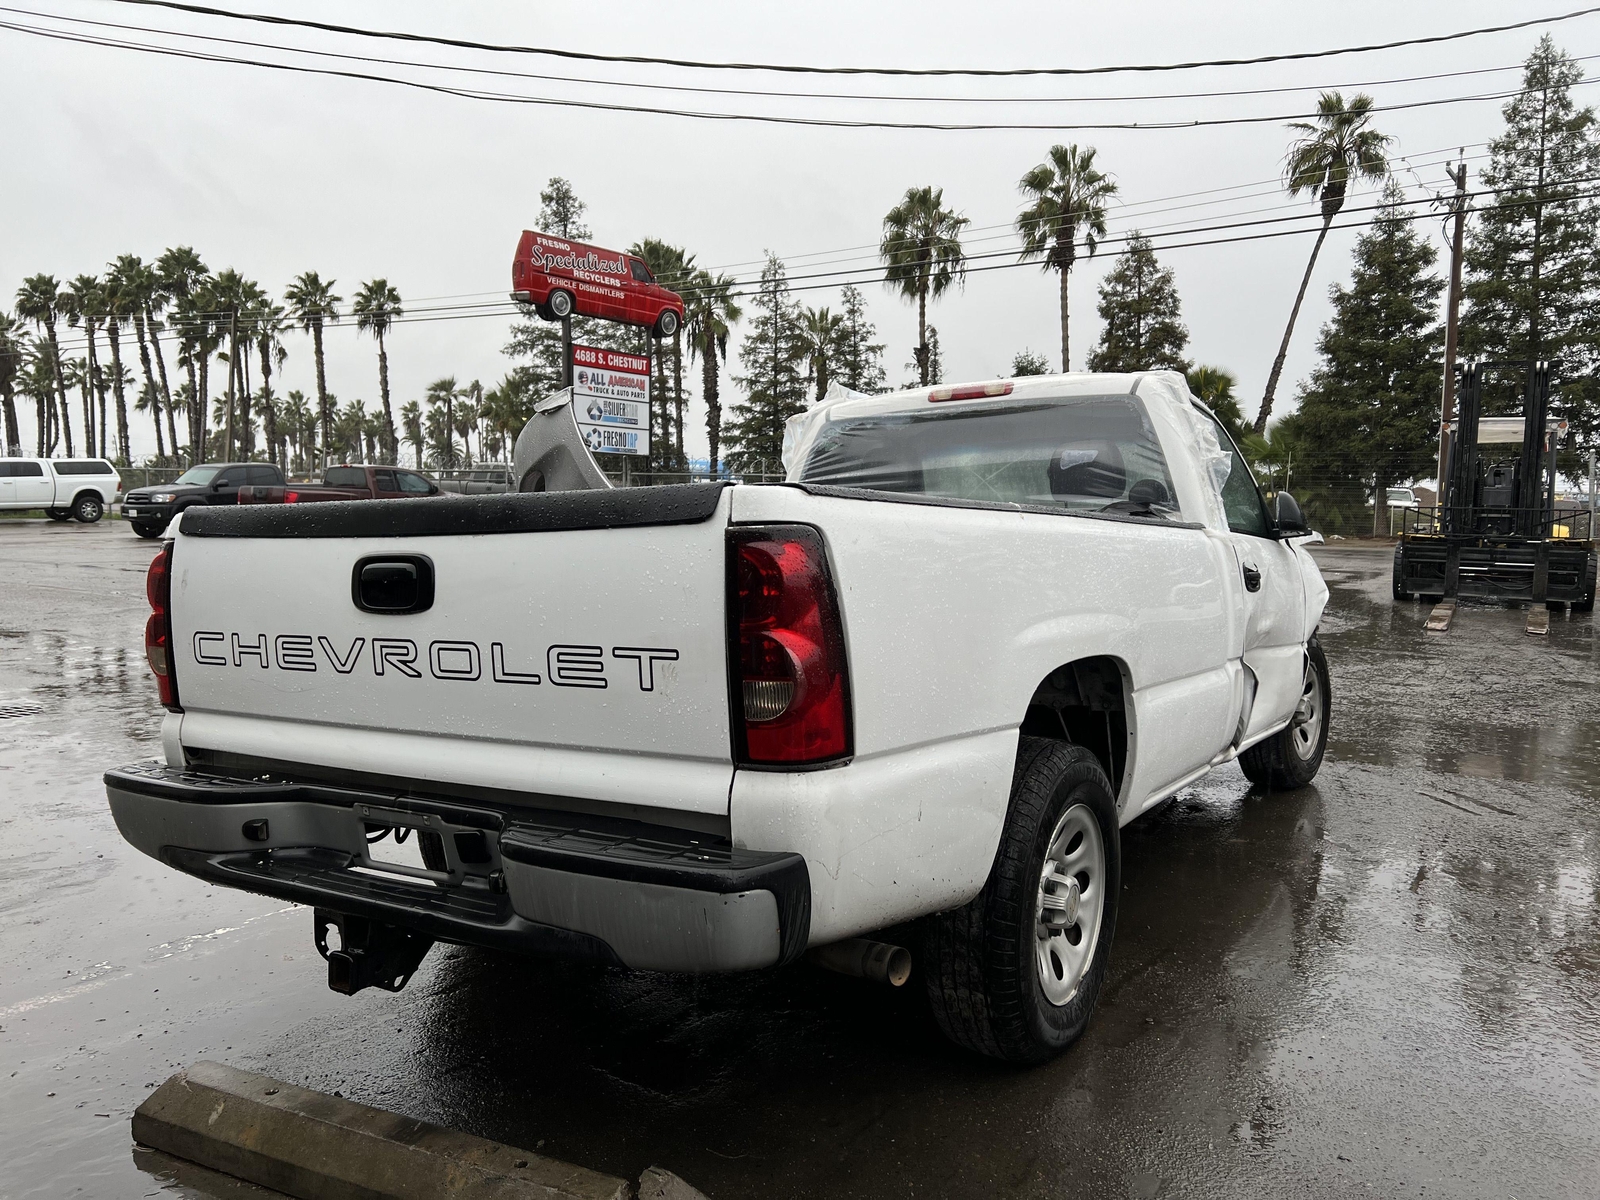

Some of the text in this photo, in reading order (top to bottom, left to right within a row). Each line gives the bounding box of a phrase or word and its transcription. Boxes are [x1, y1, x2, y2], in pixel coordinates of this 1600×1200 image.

[537, 237, 570, 251] FRESNO
[531, 245, 627, 275] Specialized
[547, 276, 625, 299] VEHICLE DISMANTLERS
[573, 269, 621, 287] RECYCLERS
[575, 349, 647, 370] 4688 S. CHESTNUT
[589, 372, 646, 391] ALL AMERICAN
[593, 386, 609, 395] TRUCK
[616, 389, 630, 398] AUTO
[630, 390, 646, 399] PARTS
[192, 630, 680, 692] CHEVROLET
